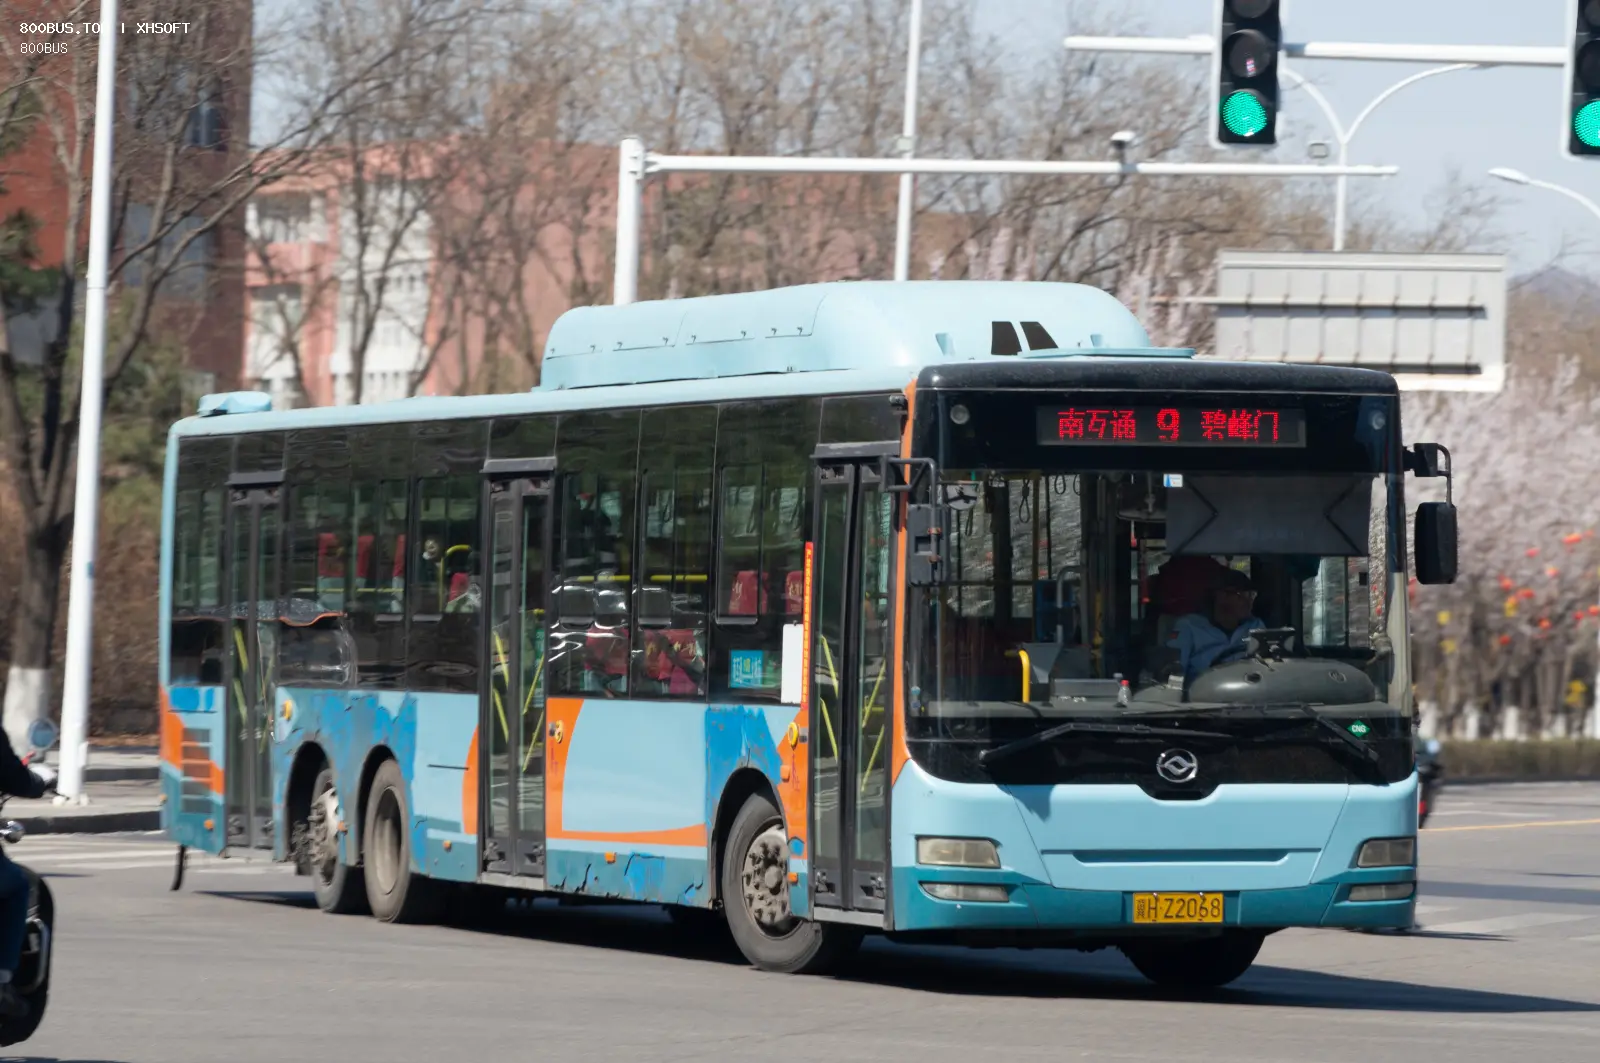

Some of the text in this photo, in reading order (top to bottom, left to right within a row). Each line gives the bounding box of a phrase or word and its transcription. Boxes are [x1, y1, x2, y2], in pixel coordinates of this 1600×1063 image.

[1156, 408, 1181, 442] 9
[1201, 408, 1279, 442] 碧峰门
